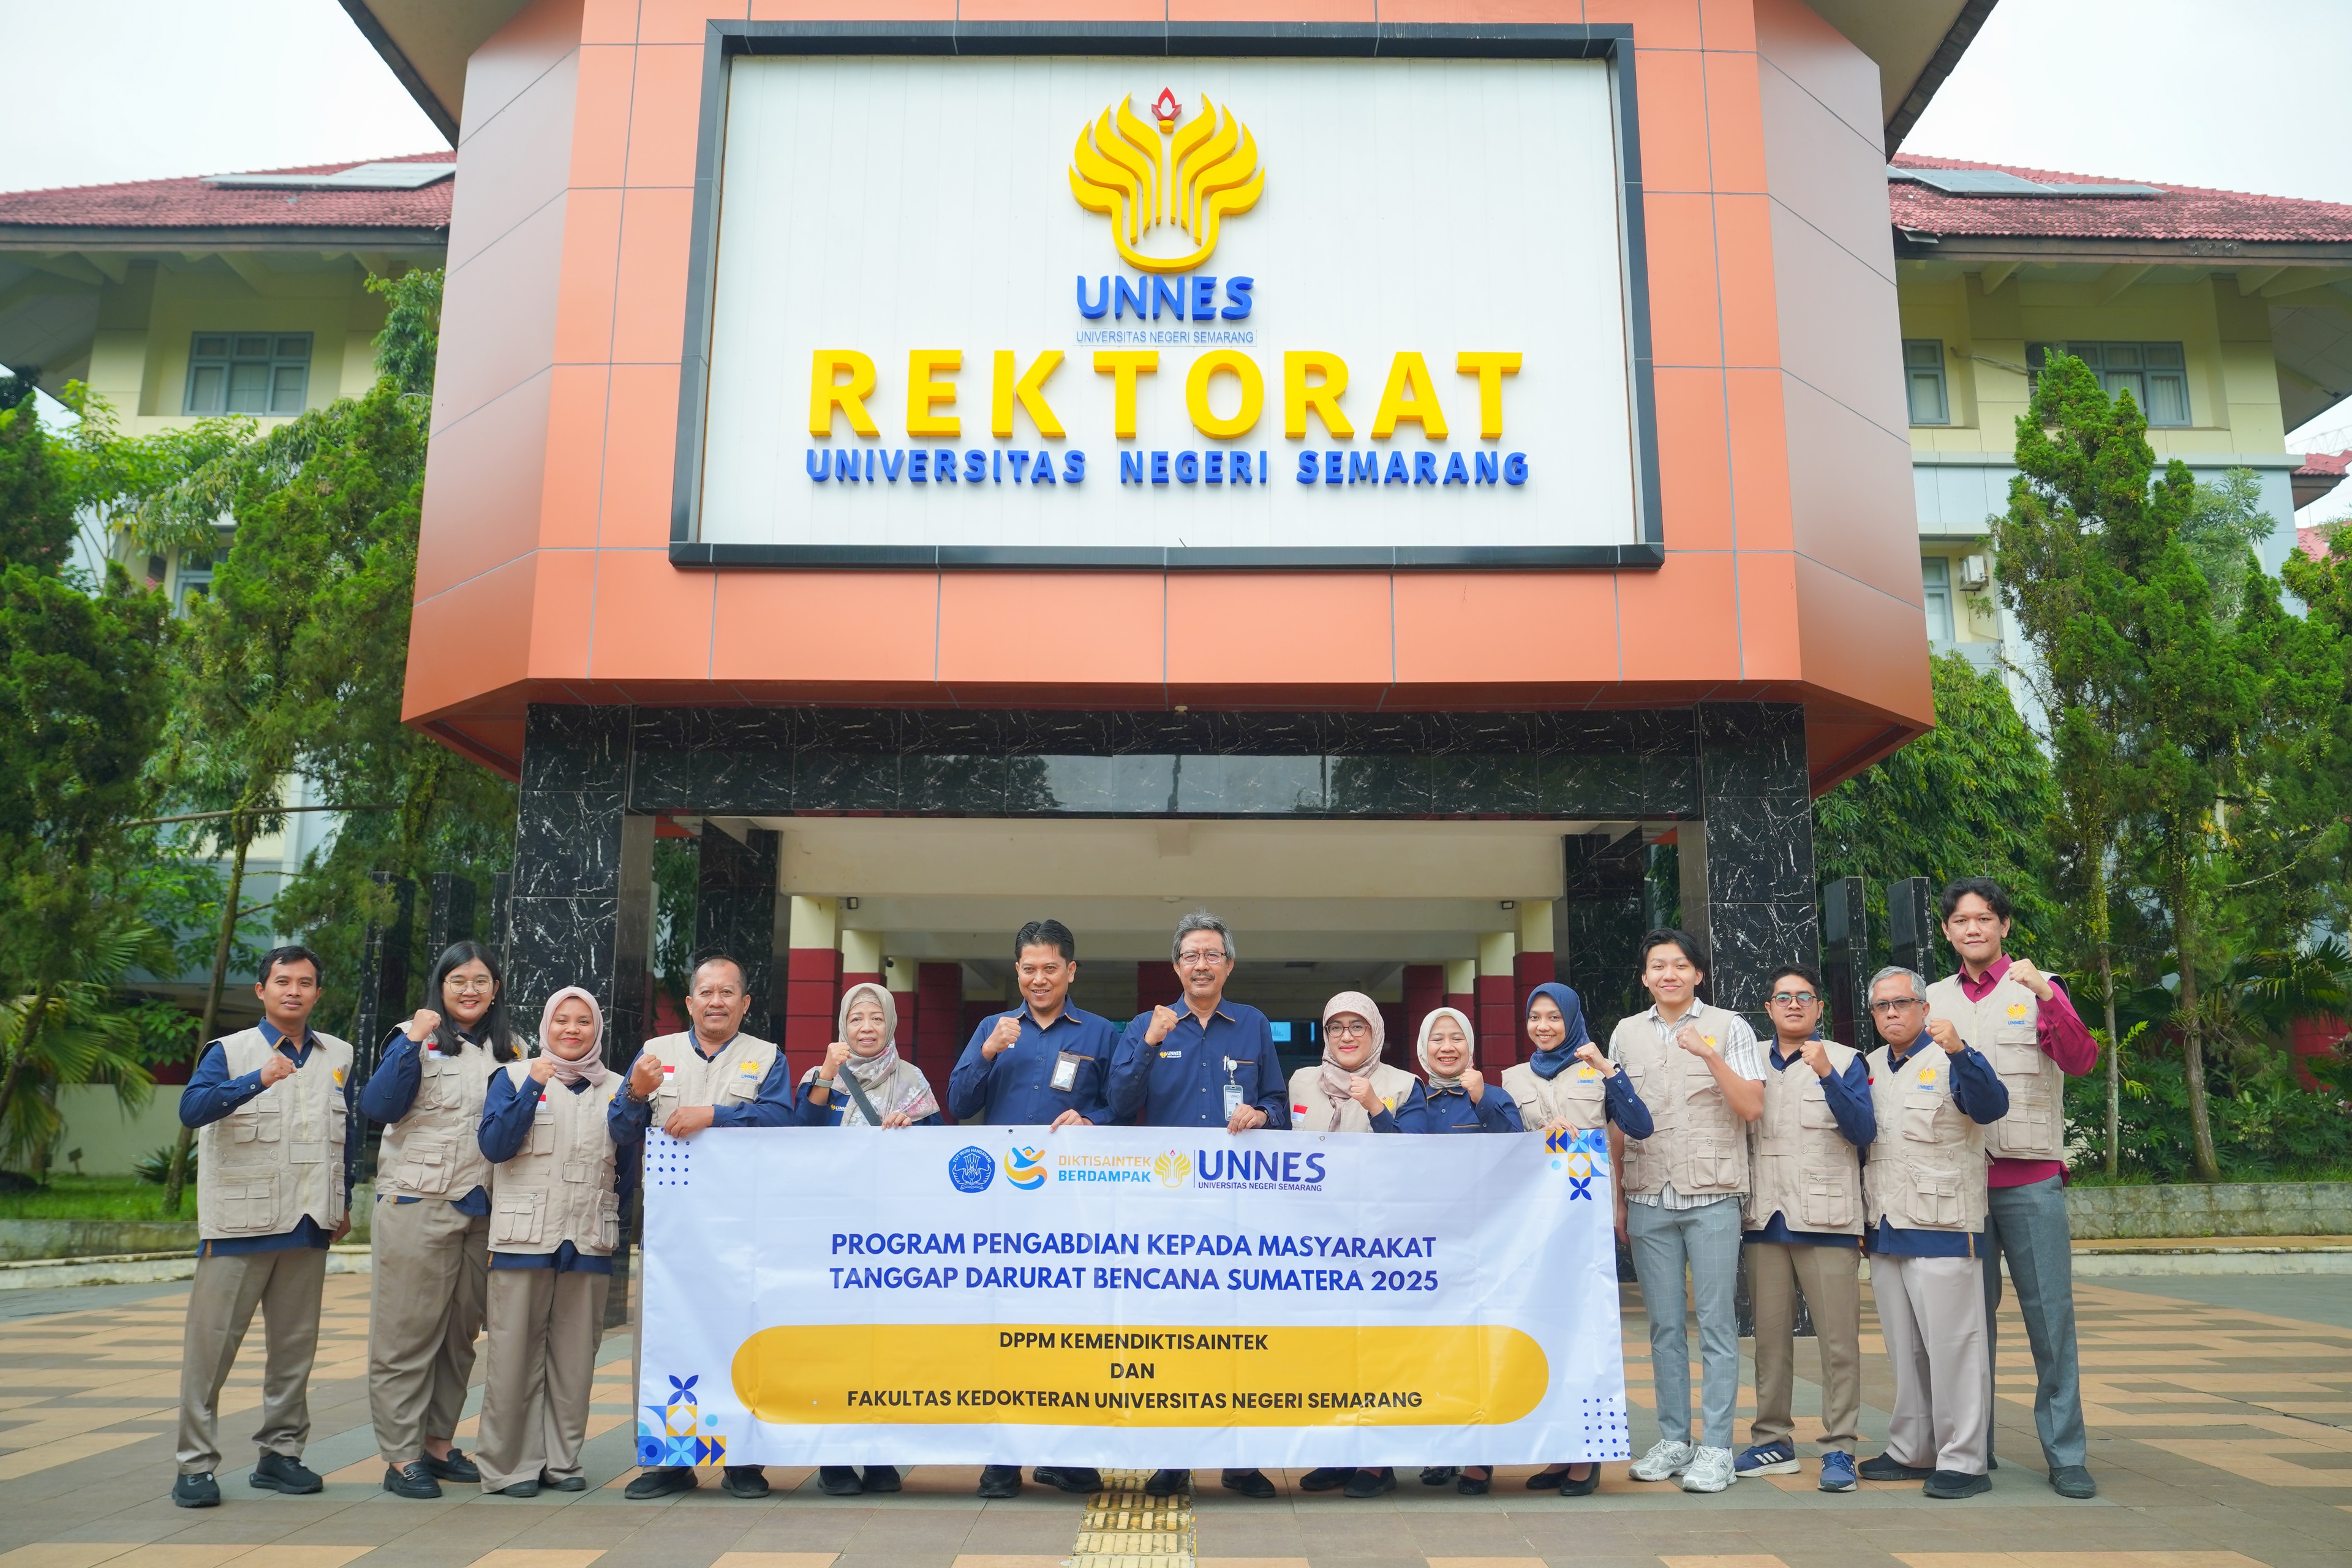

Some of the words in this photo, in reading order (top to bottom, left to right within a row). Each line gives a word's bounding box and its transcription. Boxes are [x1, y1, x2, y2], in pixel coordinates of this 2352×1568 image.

[1077, 275, 1254, 321] UNNES
[1076, 331, 1147, 343] UNIVERSITAS
[1150, 331, 1190, 343] NEGERI
[1193, 331, 1254, 343] SEMARANG
[809, 350, 1523, 440] REKTORAT
[806, 449, 1086, 484] UNIVERSITAS
[1120, 450, 1267, 484] NEGERI
[1297, 450, 1529, 486] SEMARANG
[971, 1148, 992, 1163] HANDAYANI
[1058, 1155, 1151, 1167] DIKTISAINTEK
[1199, 1150, 1326, 1183] UNNES
[1058, 1170, 1152, 1183] BERDAMPAK
[1278, 1183, 1322, 1192] SEMARANG
[832, 1232, 965, 1255] PROGRAM
[973, 1232, 1139, 1255] PENGABDIAN
[1147, 1234, 1253, 1256] KEPADA
[1258, 1235, 1436, 1259] MASYARAKAT
[829, 1267, 959, 1289] TANGGAP
[966, 1267, 1087, 1289] DARURAT
[1093, 1267, 1220, 1290] BENCANA
[1227, 1268, 1364, 1291] SUMATERA
[1371, 1270, 1438, 1291] 2025
[1000, 1332, 1055, 1348] DPPM
[1061, 1333, 1268, 1350] KEMENDIKTISAINTEK
[1110, 1363, 1155, 1379] DAN
[848, 1390, 951, 1406] FAKULTAS
[957, 1390, 1090, 1408] KEDOKTERAN
[1095, 1392, 1227, 1409] UNIVERSITAS
[1232, 1393, 1302, 1409] NEGERI
[1308, 1392, 1422, 1408] SEMARANG
